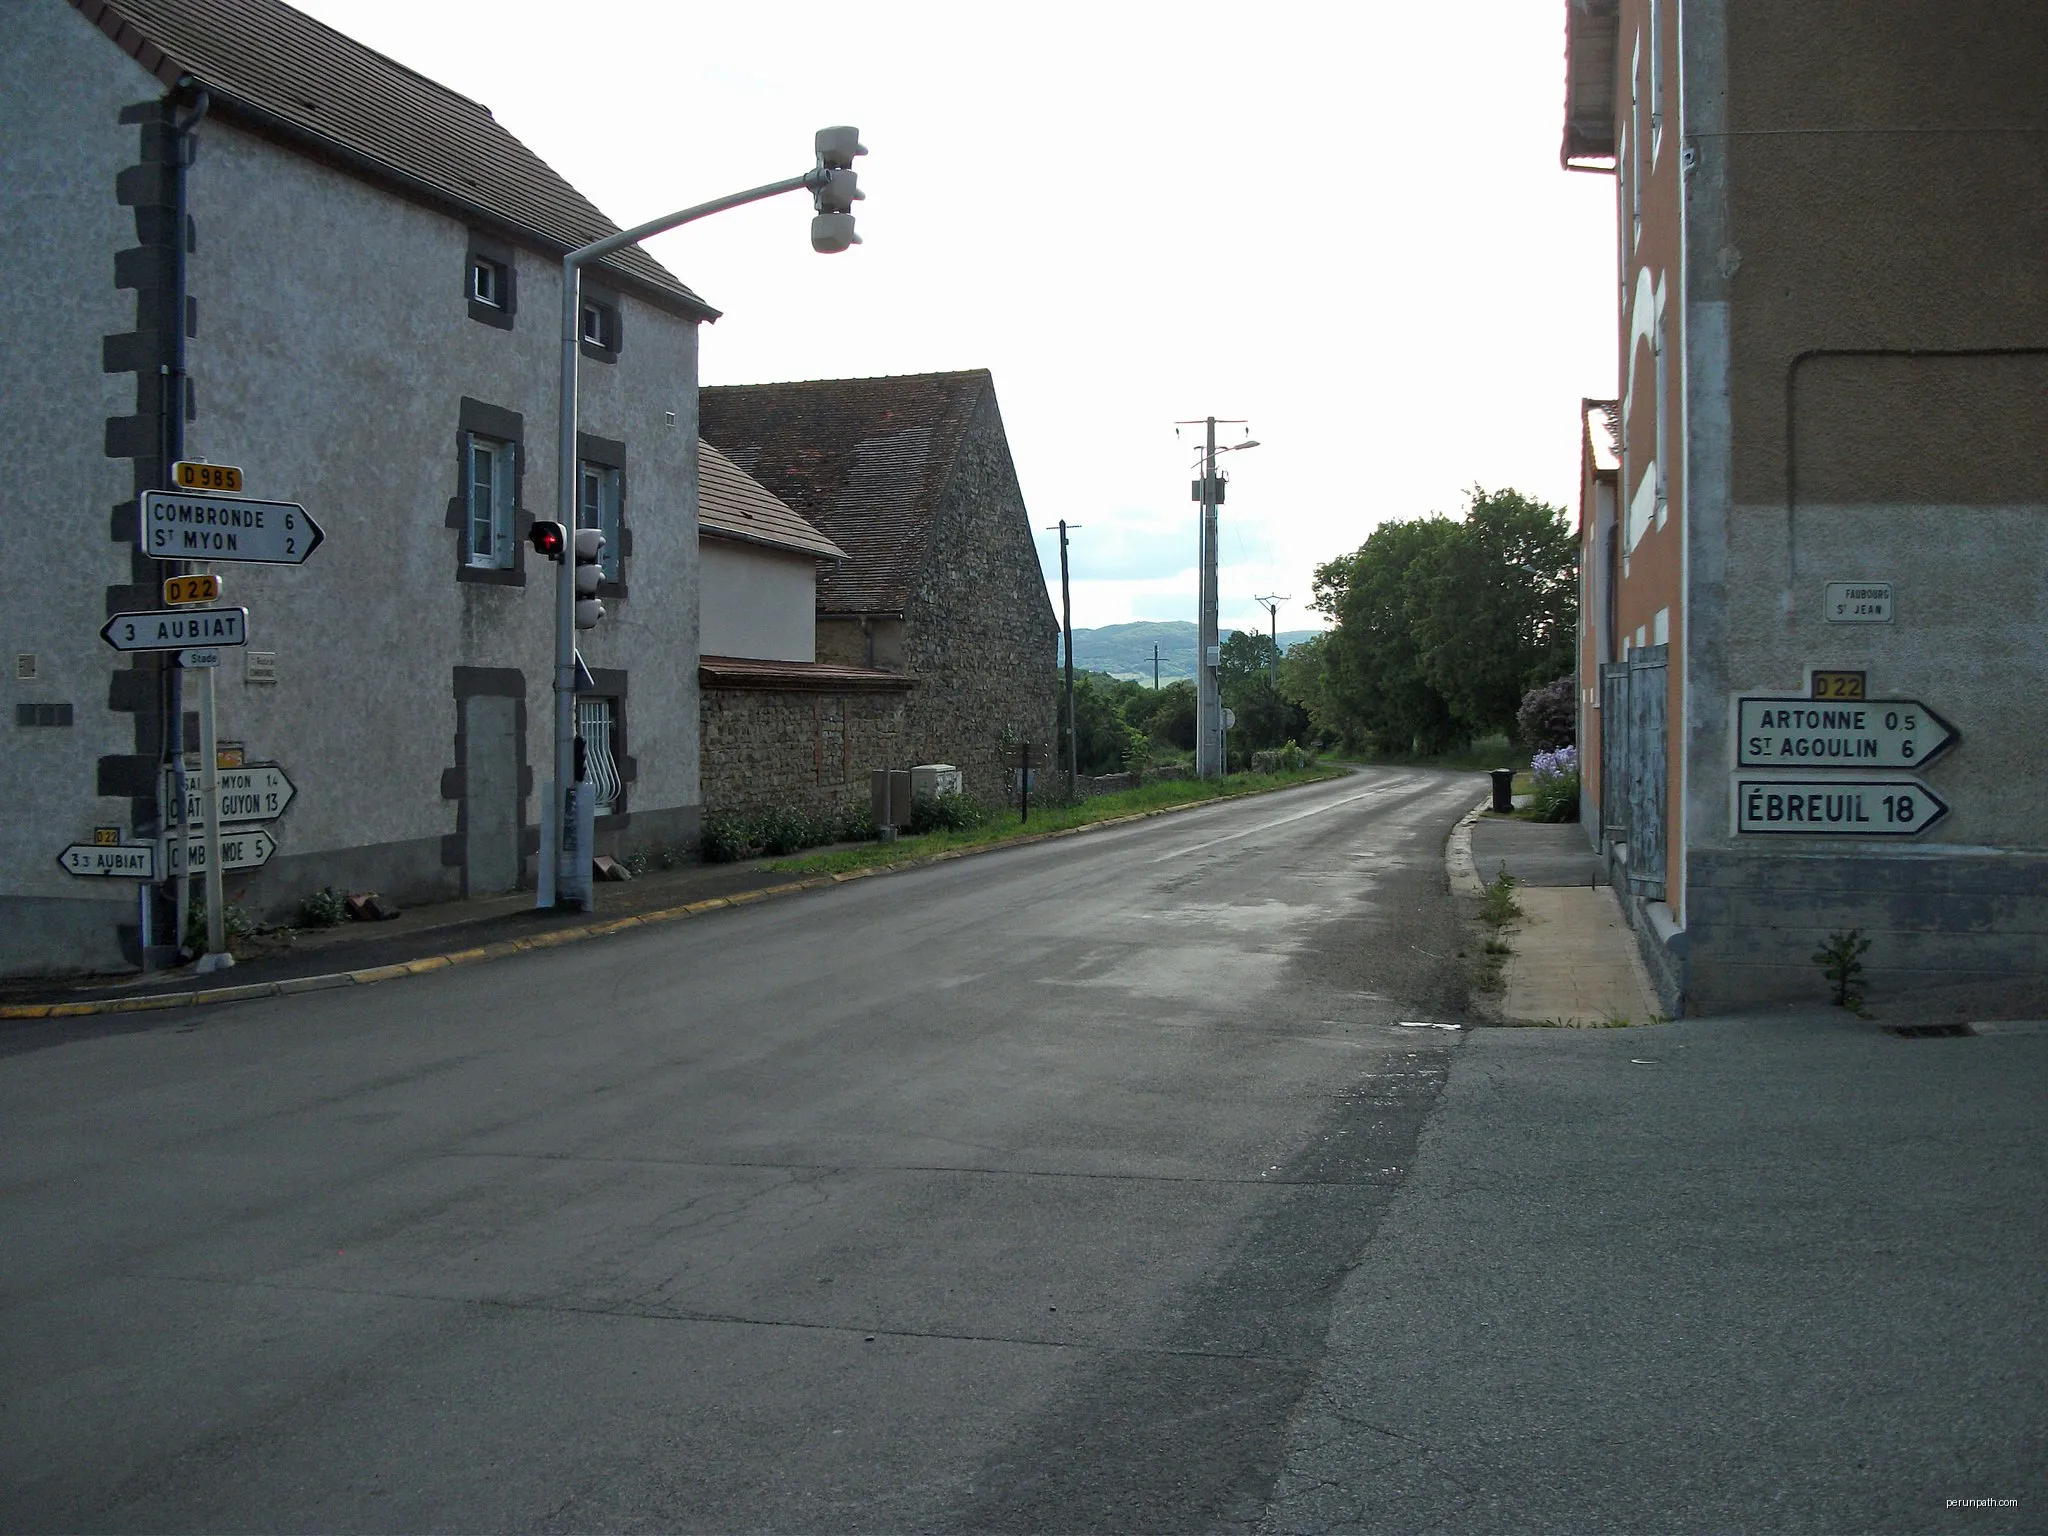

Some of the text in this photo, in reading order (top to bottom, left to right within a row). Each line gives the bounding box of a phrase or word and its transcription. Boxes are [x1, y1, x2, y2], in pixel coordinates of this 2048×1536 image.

[185, 467, 235, 487] D 985
[154, 503, 294, 530] COMBRONDE 6
[184, 531, 237, 550] MYON
[286, 538, 295, 554] 2
[171, 580, 213, 600] D 22
[1845, 589, 1889, 600] FAUBOURG
[1853, 604, 1882, 615] JEAN
[125, 617, 236, 641] 3 AUBIAT
[191, 653, 217, 664] Stade
[1816, 678, 1861, 696] D 22
[1760, 710, 1866, 730] ARTONNE
[1780, 738, 1877, 758] AGOULIN
[1901, 739, 1914, 758] 6
[266, 793, 278, 812] 13
[1747, 788, 1914, 822] ÉBREUIL 18
[97, 831, 117, 843] D 22
[255, 839, 264, 858] 5
[97, 854, 144, 869] AUBIAT
